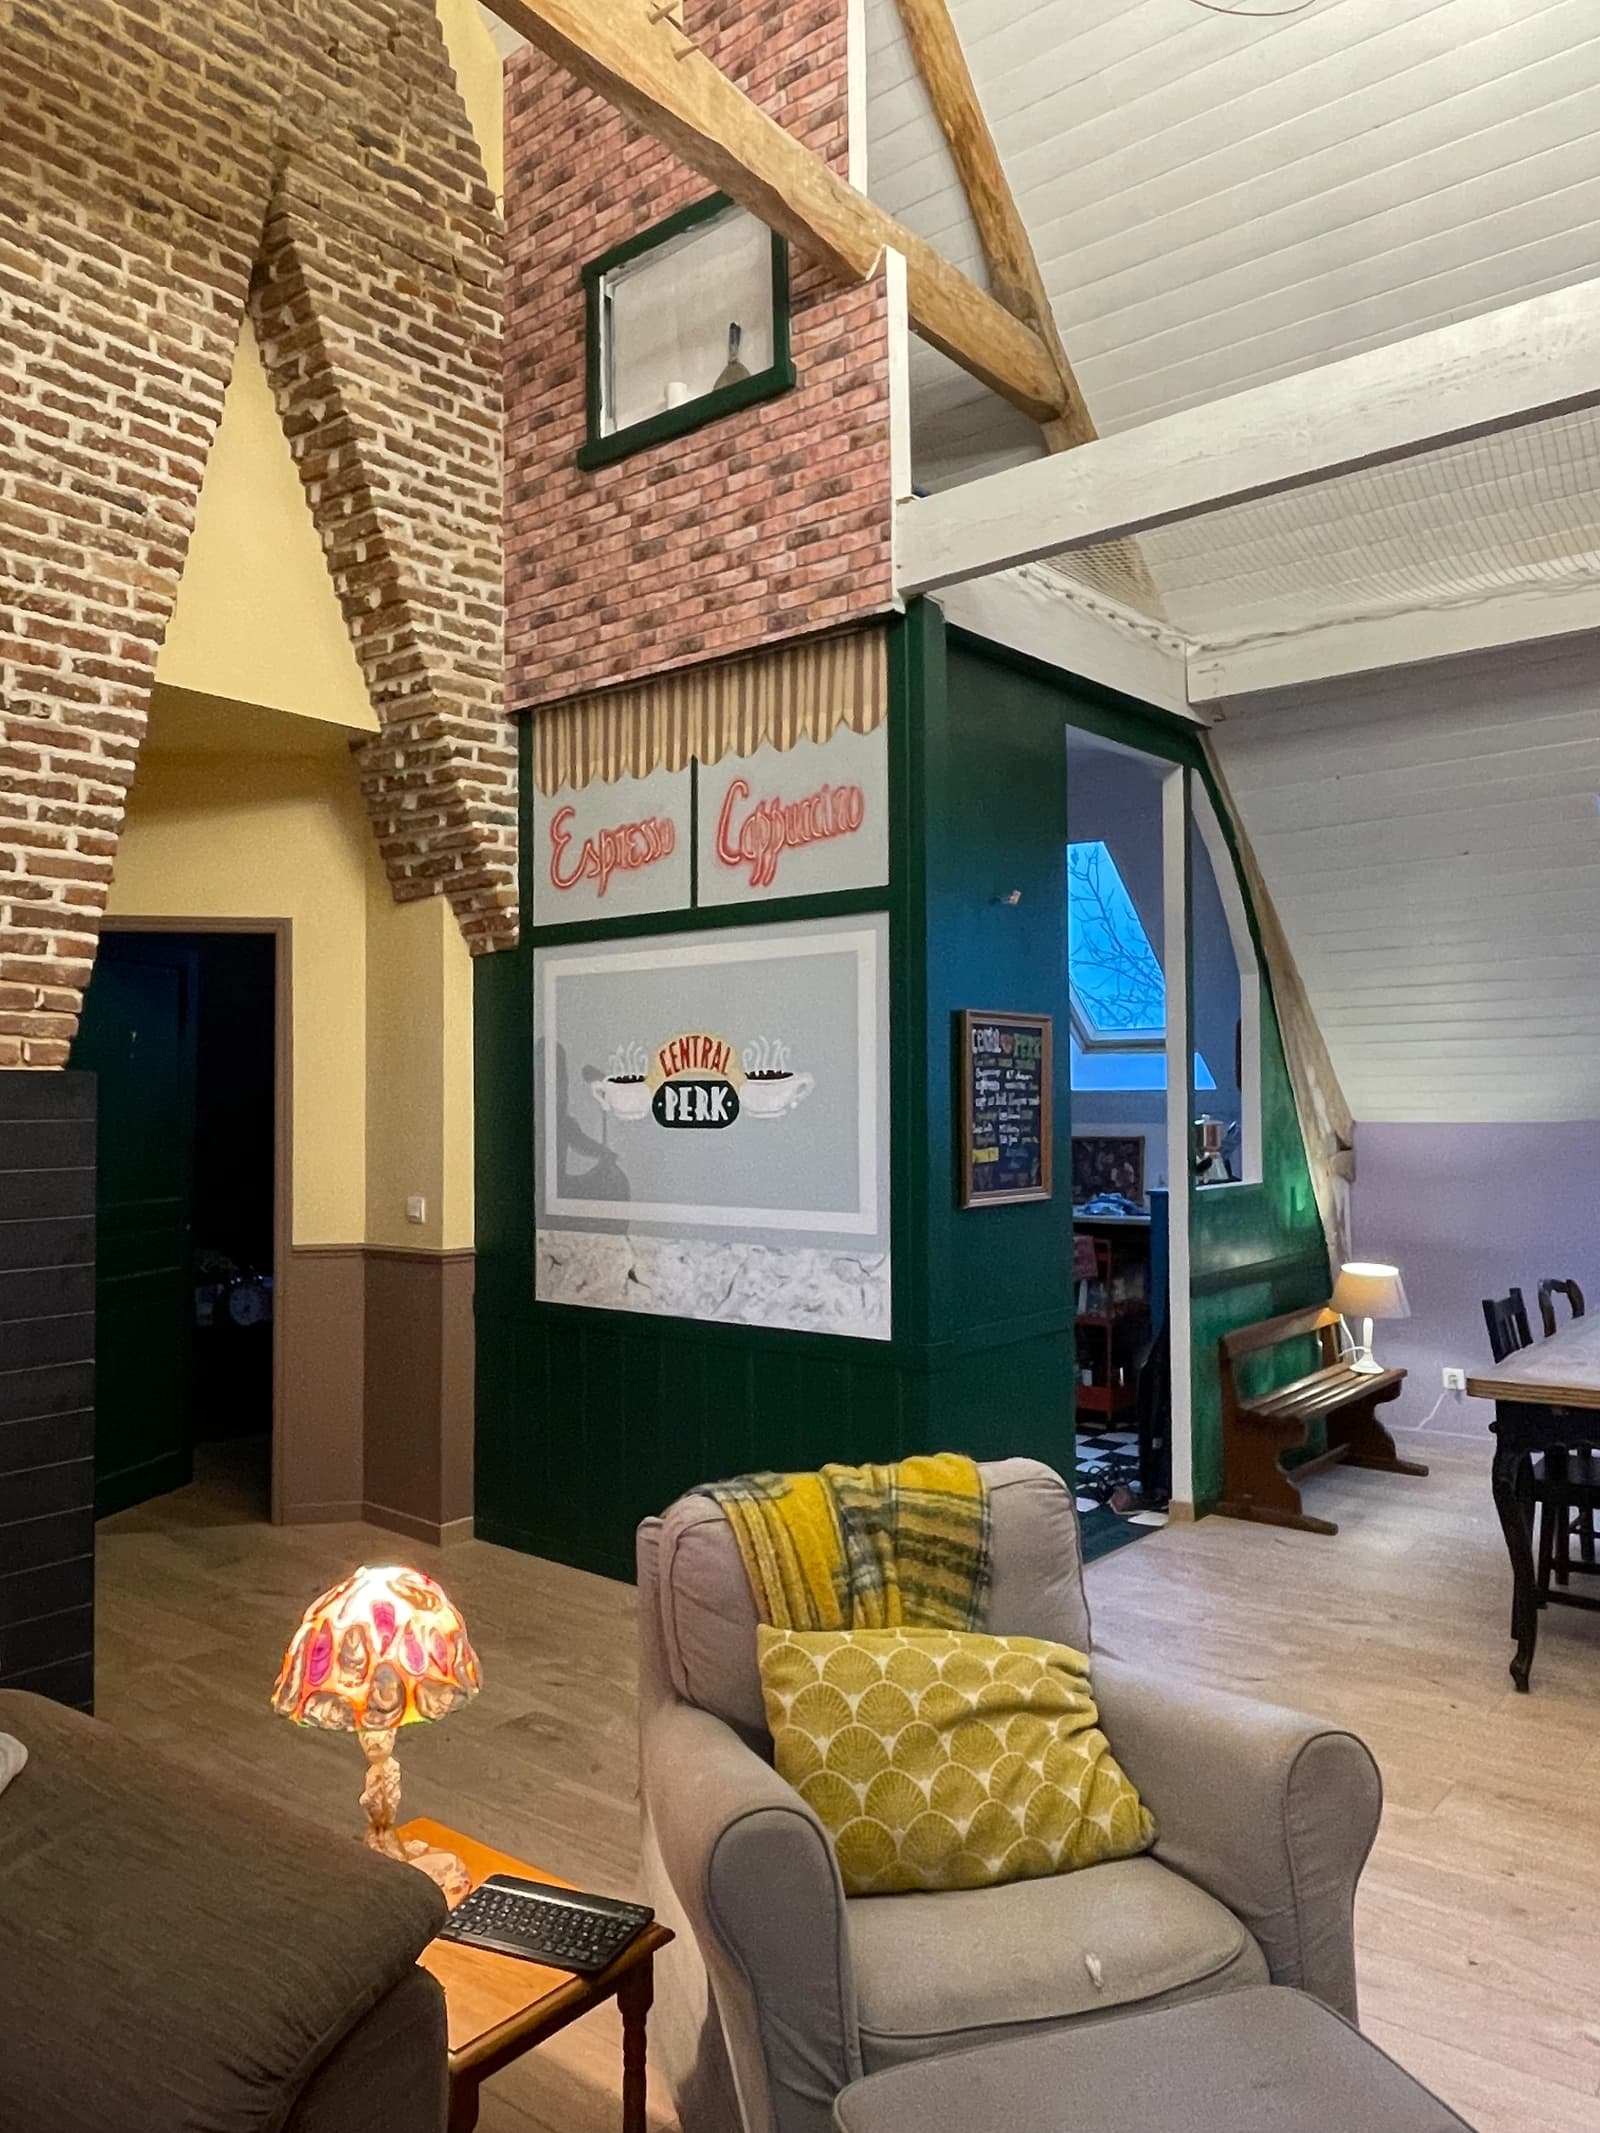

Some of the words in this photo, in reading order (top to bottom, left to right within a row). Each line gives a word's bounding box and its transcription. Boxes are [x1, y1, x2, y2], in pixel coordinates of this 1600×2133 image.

[551, 806, 675, 897] Espresso
[658, 1034, 731, 1078] CENTRAL
[664, 1085, 729, 1121] PERK
